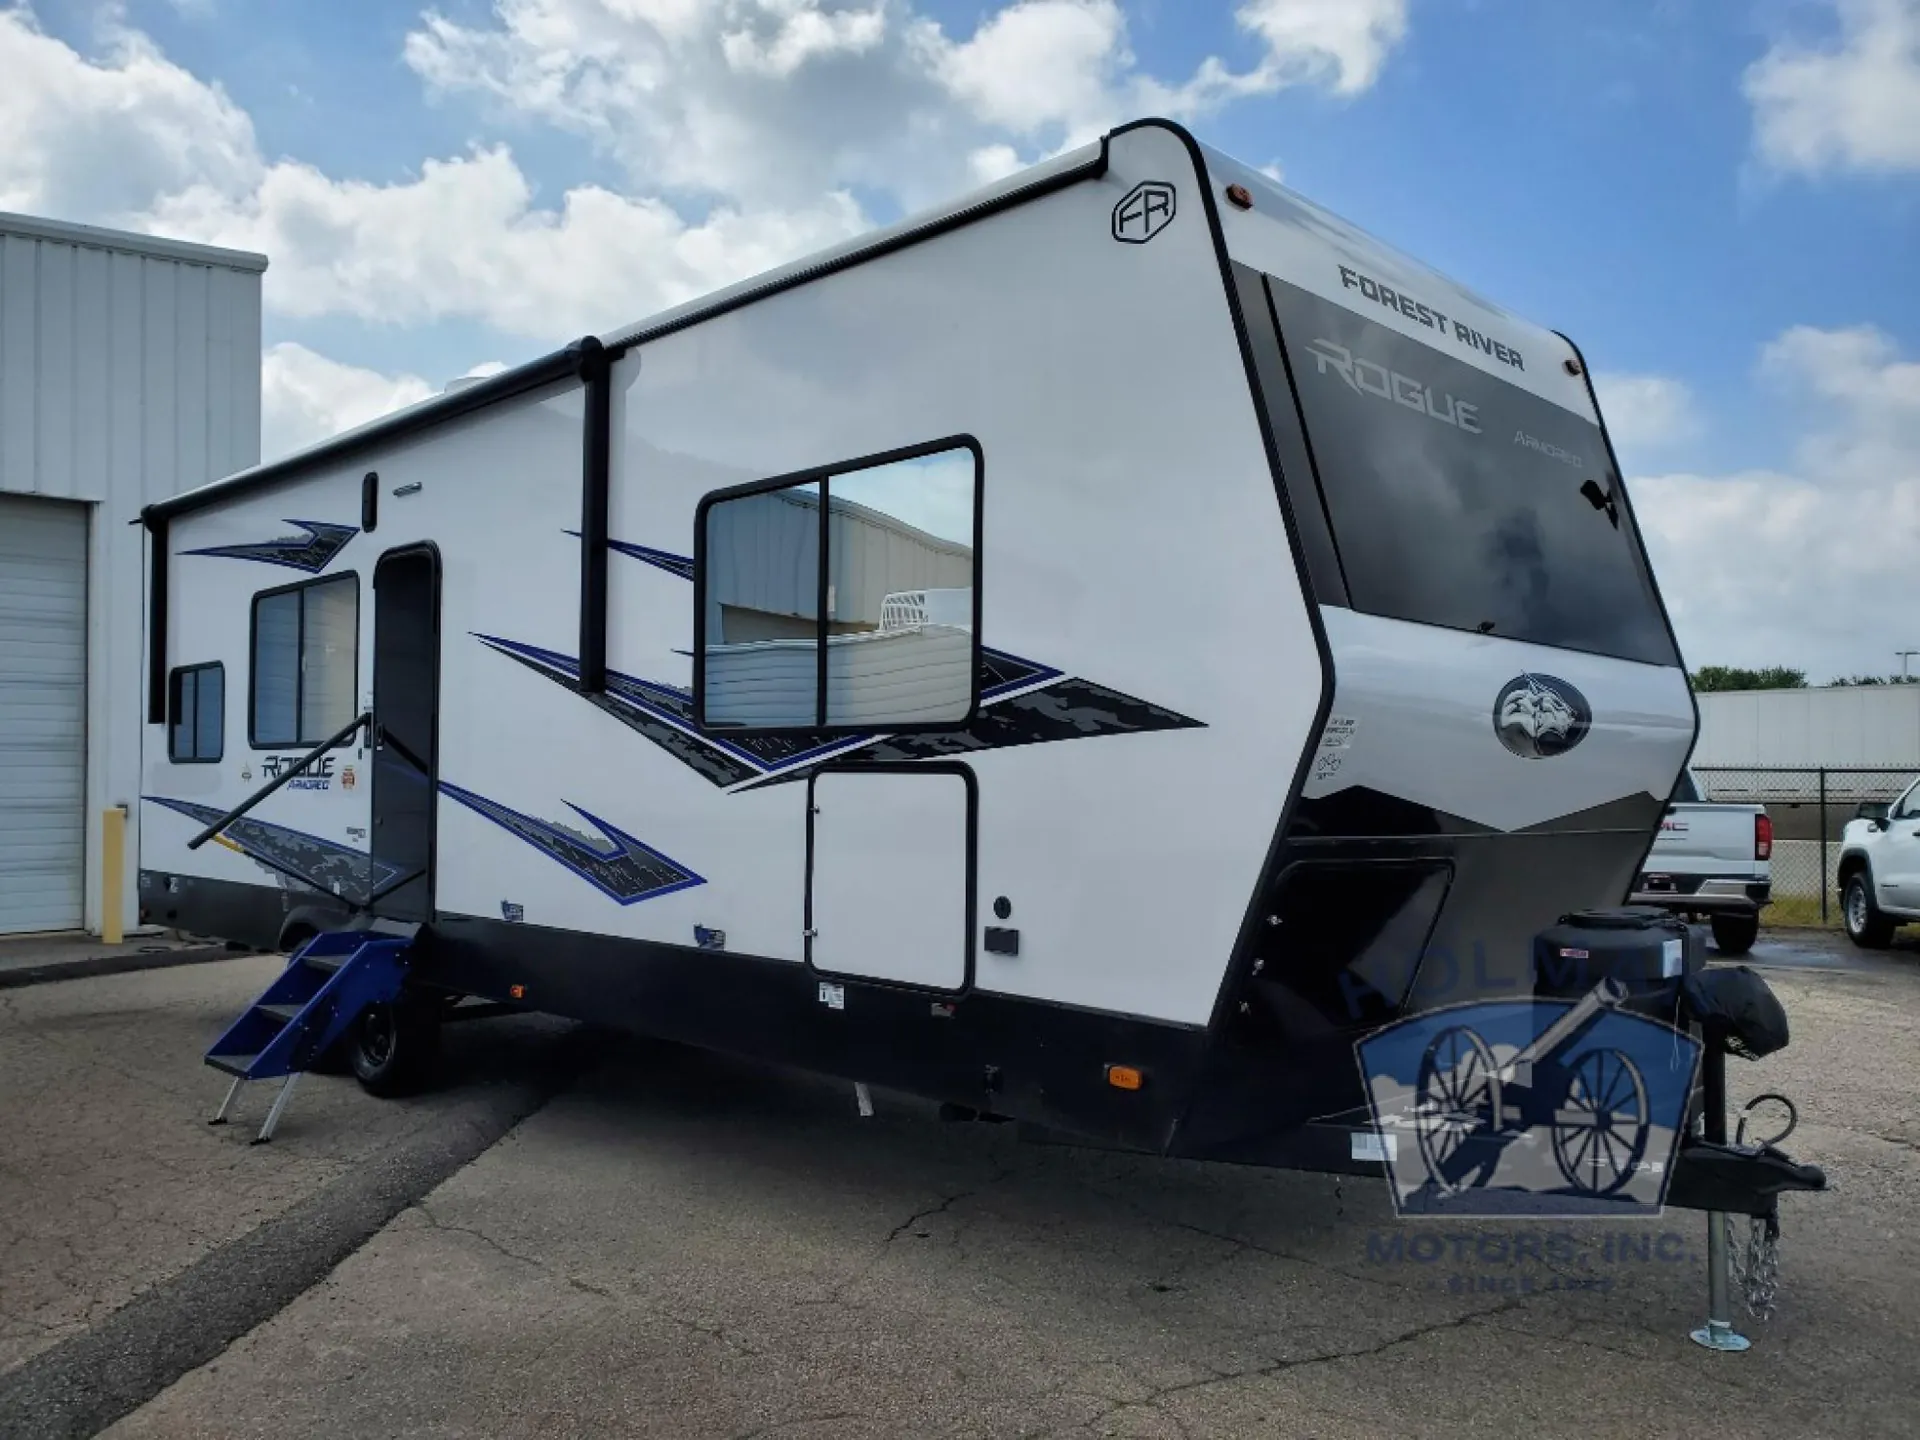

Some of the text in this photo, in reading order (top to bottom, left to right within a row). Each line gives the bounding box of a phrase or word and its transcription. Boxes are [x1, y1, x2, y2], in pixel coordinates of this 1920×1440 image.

[1337, 264, 1526, 373] FOREST RIVER
[1305, 338, 1484, 435] ROGUE
[1514, 430, 1584, 469] ARMORED
[1661, 820, 1689, 831] MC
